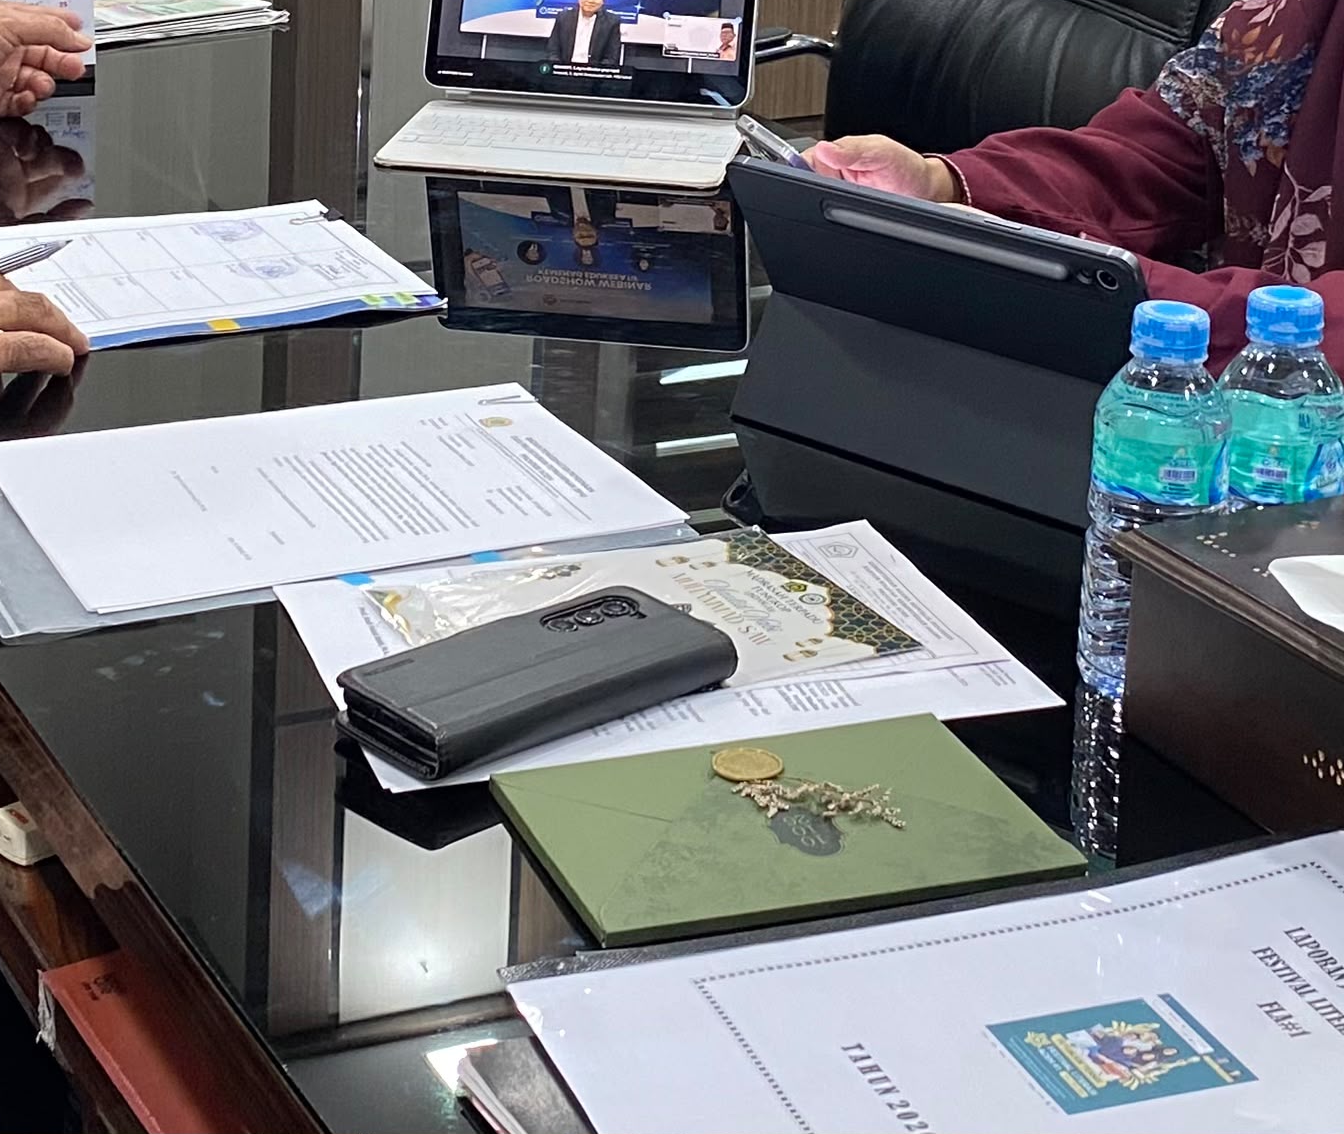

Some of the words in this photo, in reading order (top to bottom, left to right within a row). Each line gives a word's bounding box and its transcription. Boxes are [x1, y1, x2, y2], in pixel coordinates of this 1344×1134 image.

[1251, 946, 1319, 998] FESTIVAL
[1256, 1000, 1312, 1038] FLA#1
[841, 1042, 901, 1096] TAHUN
[885, 1099, 937, 1134] 202
